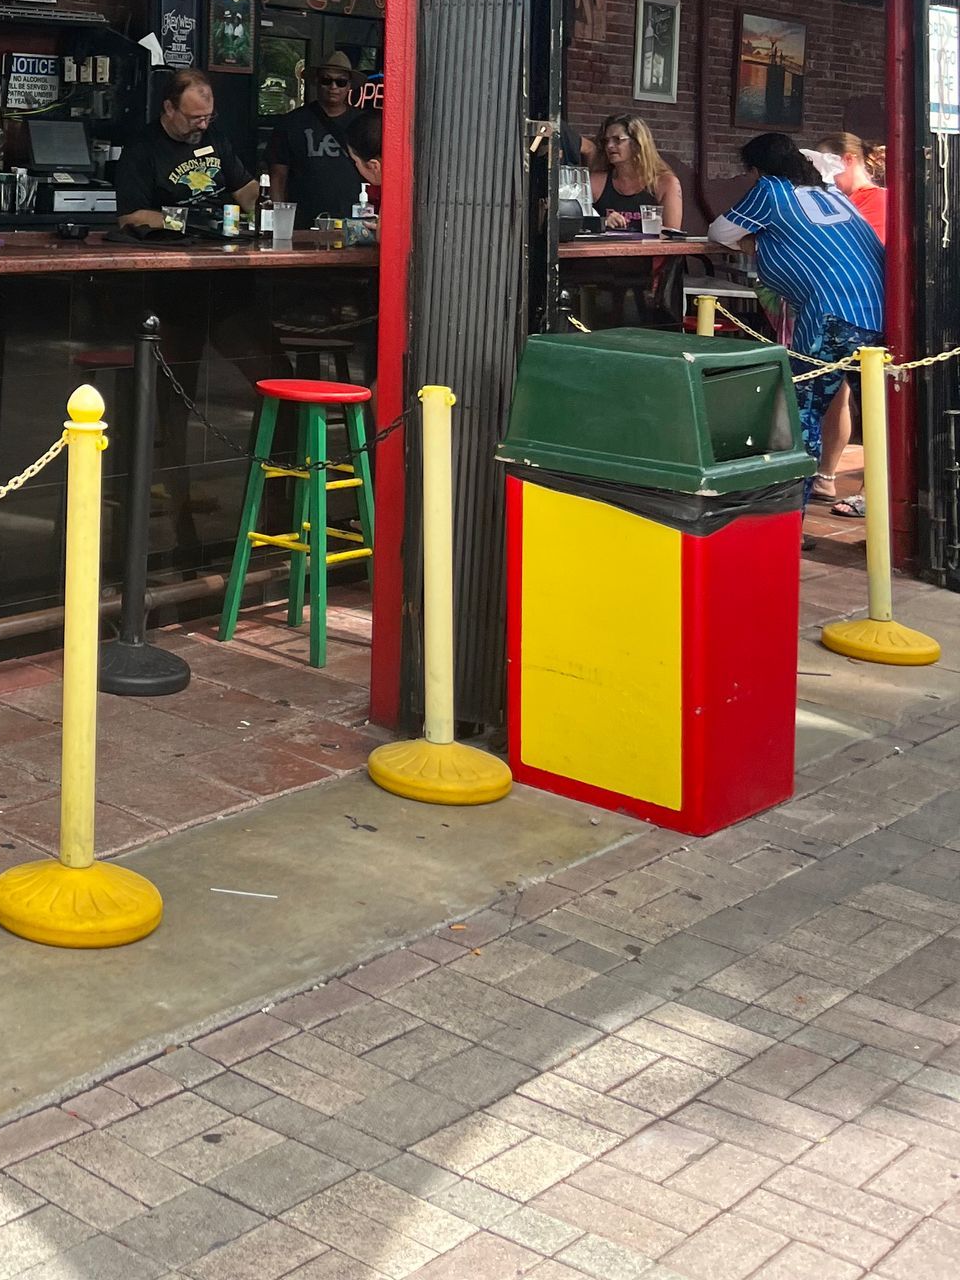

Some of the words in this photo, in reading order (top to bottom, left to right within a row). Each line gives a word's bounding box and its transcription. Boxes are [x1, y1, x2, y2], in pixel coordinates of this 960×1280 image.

[12, 57, 55, 74] NOTICE
[348, 83, 384, 109] OPE
[304, 128, 349, 158] Le
[168, 171, 180, 185] EL
